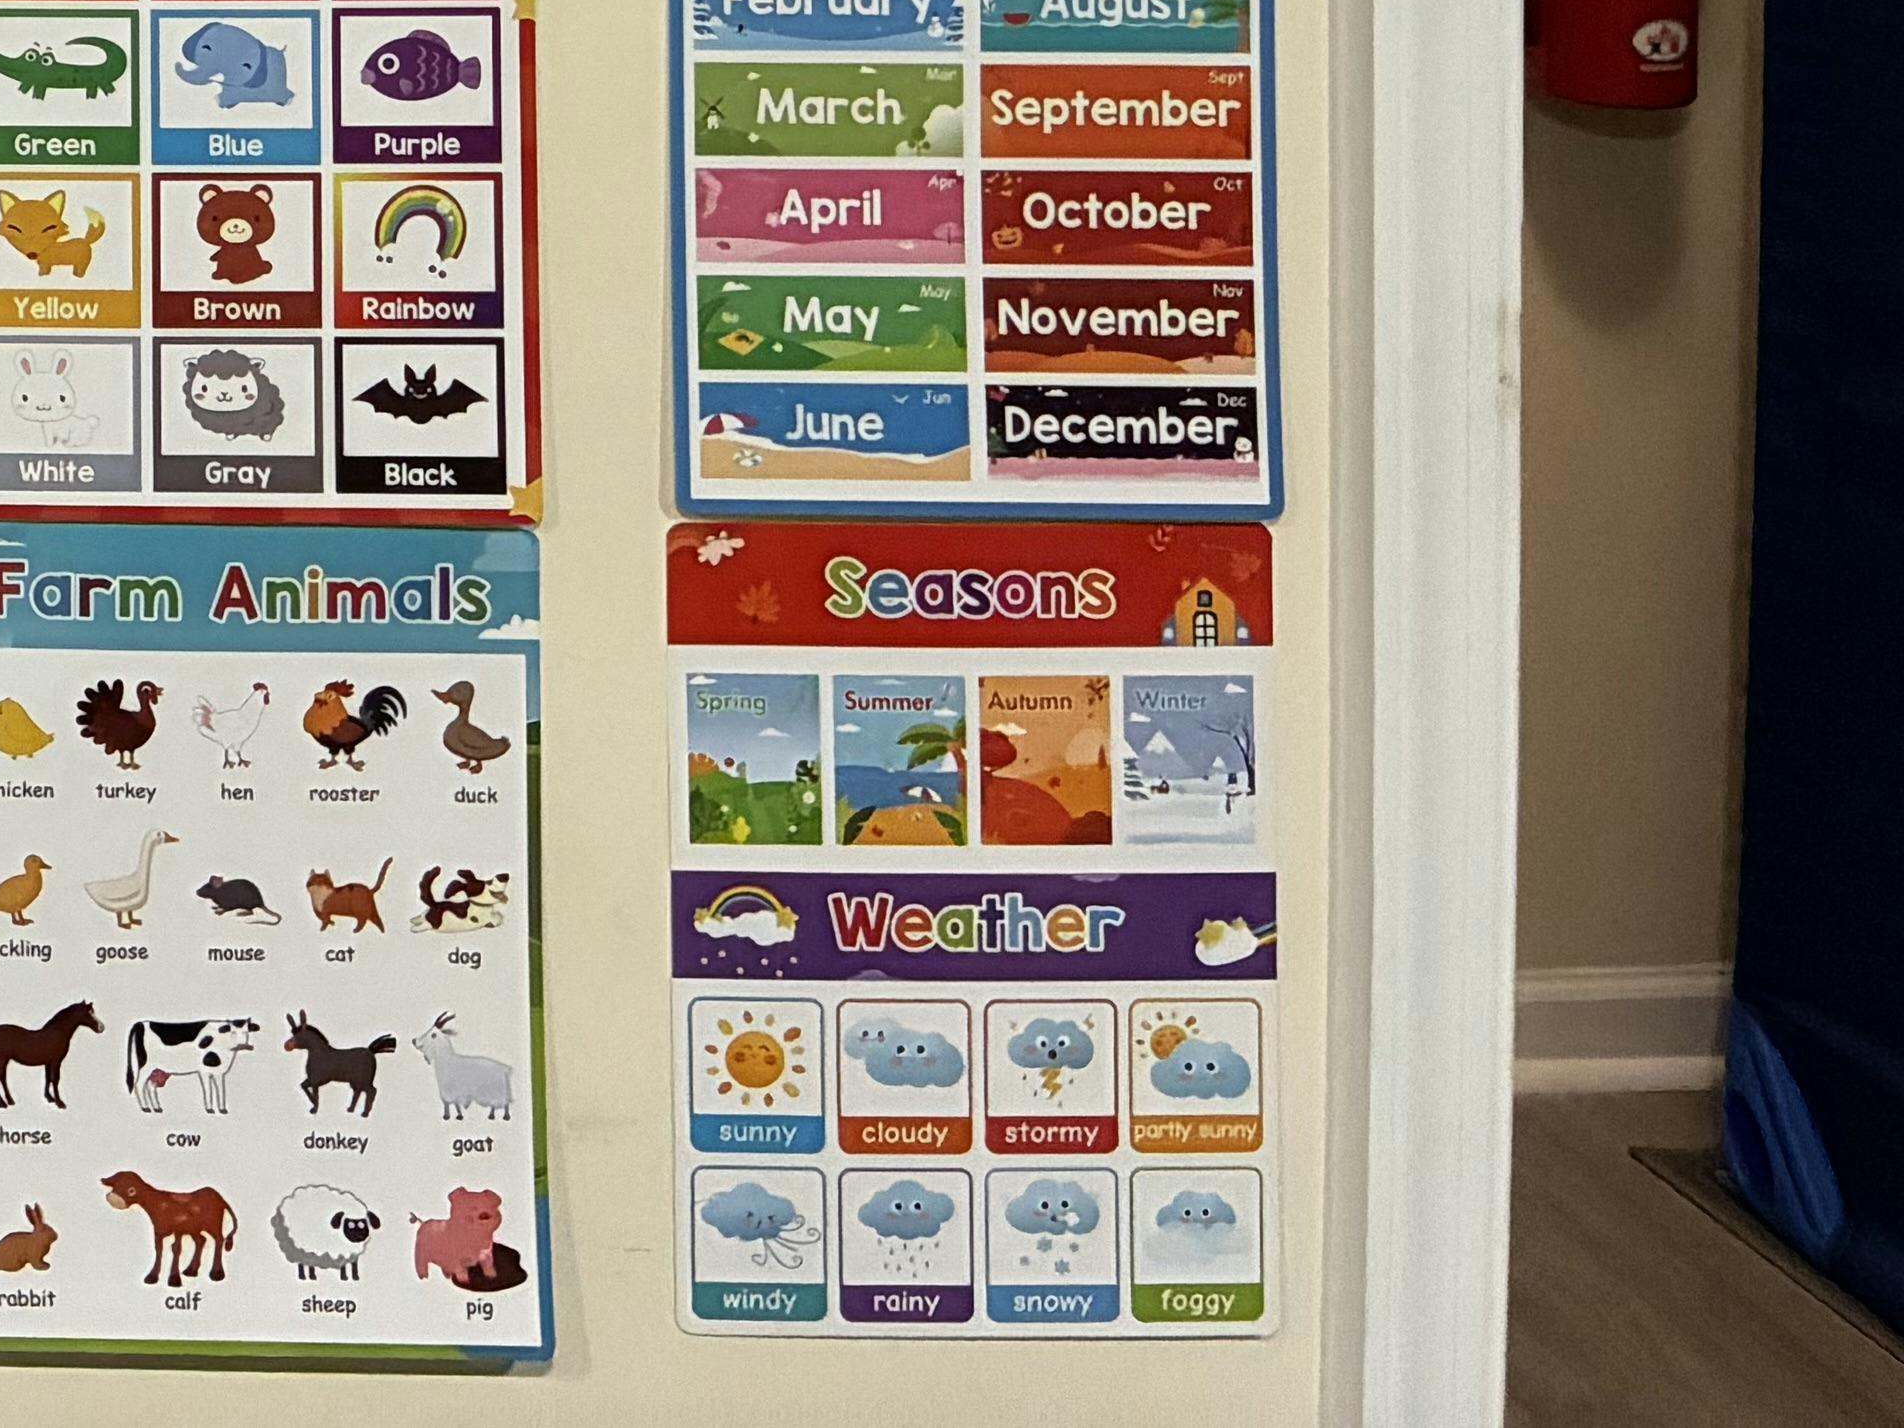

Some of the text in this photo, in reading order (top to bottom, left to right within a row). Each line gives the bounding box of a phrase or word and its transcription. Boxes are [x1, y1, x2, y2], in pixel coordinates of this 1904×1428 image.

[756, 87, 902, 124] March
[992, 87, 1241, 136] September
[14, 134, 96, 157] Green
[208, 134, 263, 157] Blue
[373, 133, 461, 161] Purple
[778, 188, 882, 234] April
[1023, 192, 1212, 230] October
[14, 297, 99, 321] Yellow
[193, 298, 281, 321] Brown
[362, 297, 475, 321] Rainbow
[782, 296, 880, 342] May
[998, 298, 1240, 338] November
[786, 404, 884, 441] June
[1004, 406, 1239, 445] December
[18, 461, 95, 484] White
[204, 462, 271, 488] Gray
[384, 462, 457, 487] Black
[209, 561, 491, 624] Animals
[824, 556, 1117, 620] Seasons
[844, 690, 934, 711] Summer
[988, 692, 1072, 711] Autumn
[828, 892, 1125, 952] Weather
[303, 1133, 369, 1152] donkey
[1005, 1122, 1099, 1147] stormy
[1161, 1290, 1236, 1316] foggy
